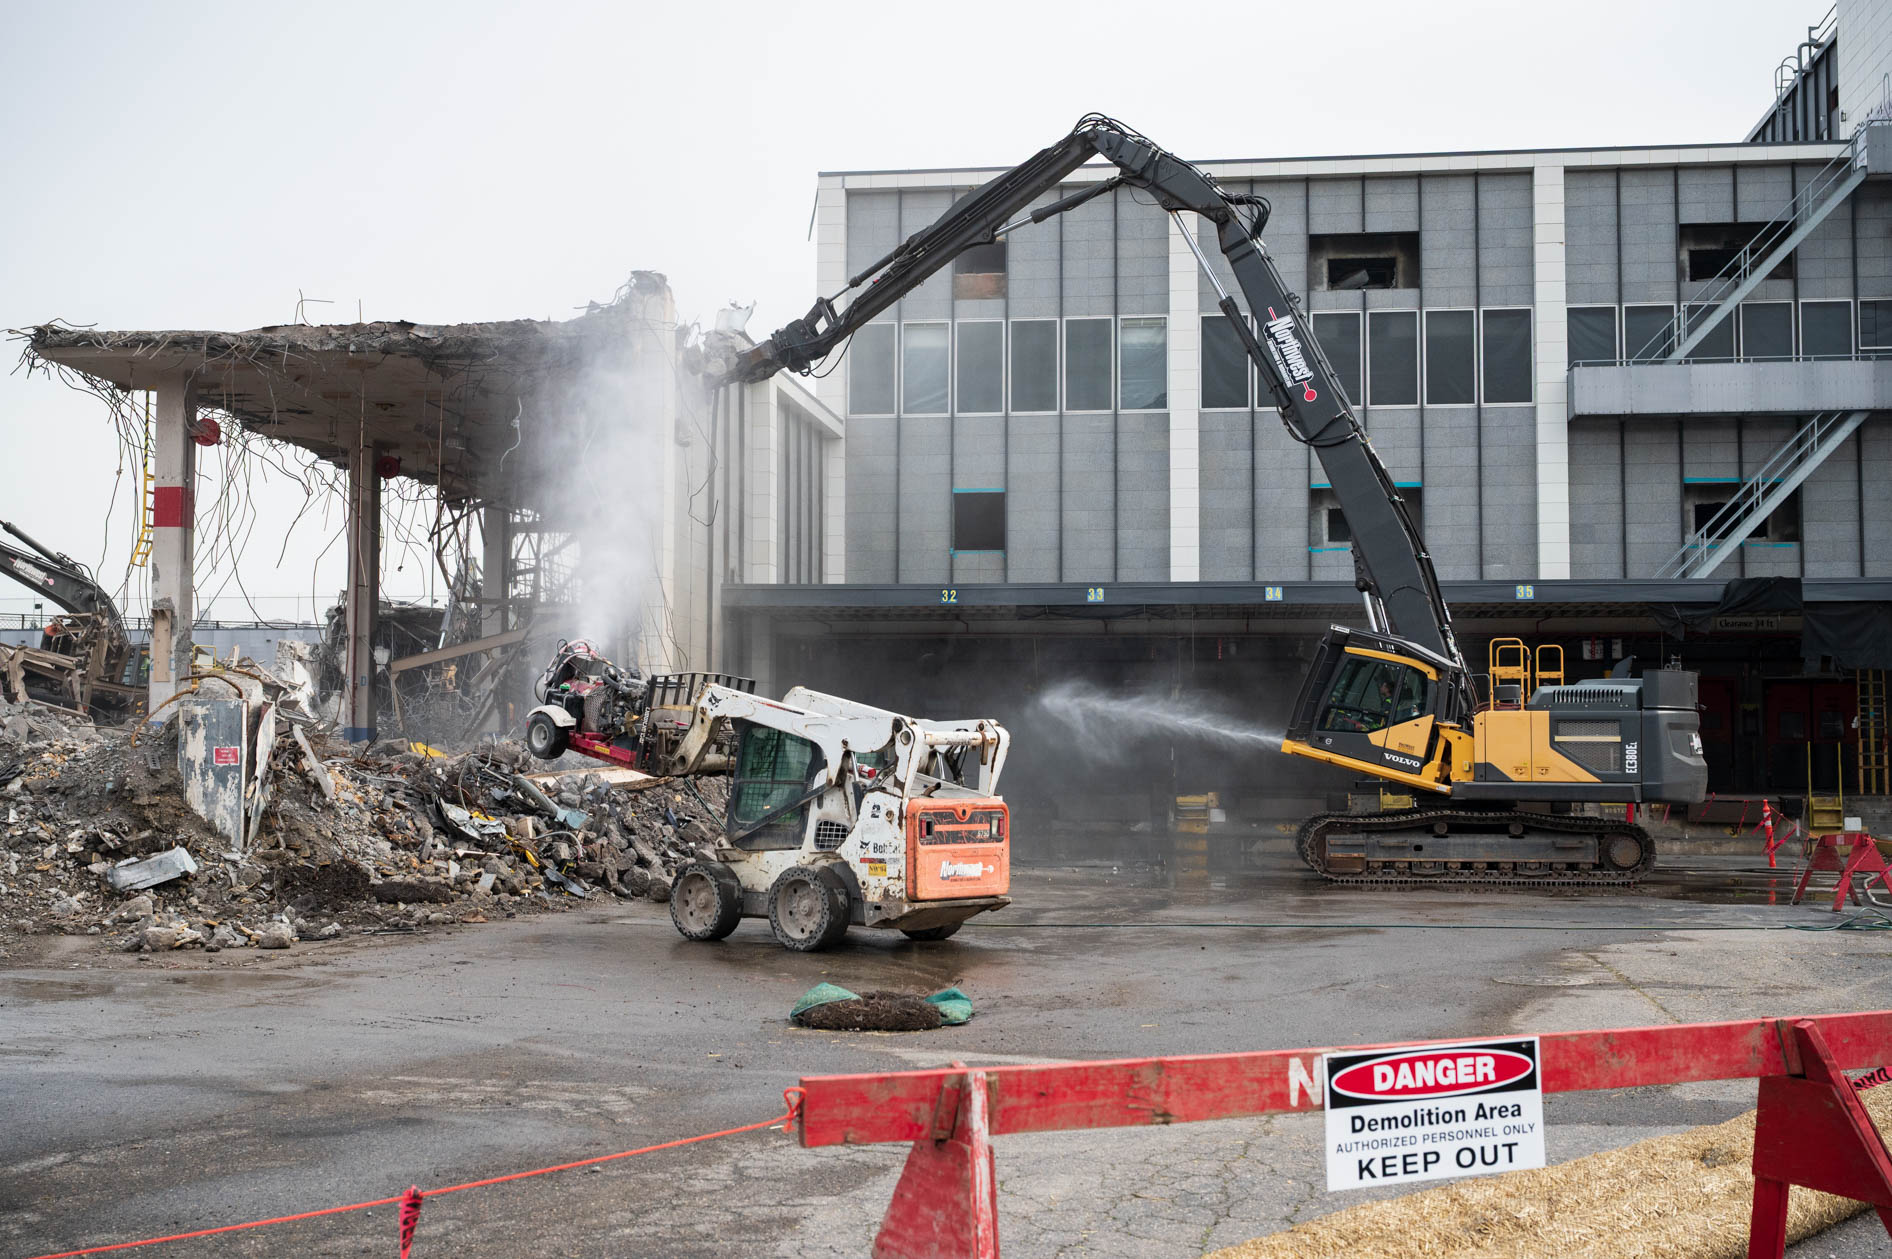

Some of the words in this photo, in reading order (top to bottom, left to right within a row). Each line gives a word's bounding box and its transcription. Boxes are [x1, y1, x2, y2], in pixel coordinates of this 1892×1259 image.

[1267, 315, 1314, 382] Northwest
[942, 590, 956, 601] 32
[1088, 588, 1103, 601] 33
[1266, 587, 1281, 600] 34
[1517, 586, 1533, 598] 35
[1384, 753, 1420, 767] VOLVO
[1373, 1055, 1496, 1092] DANGER
[1350, 1106, 1466, 1134] Demolition
[1474, 1102, 1522, 1122] Area
[1336, 1135, 1417, 1154] AUTHORIZED
[1422, 1127, 1498, 1144] PERSONNEL
[1503, 1122, 1535, 1136] ONLY
[1358, 1150, 1440, 1180] KEEP
[1455, 1142, 1519, 1169] OUT
